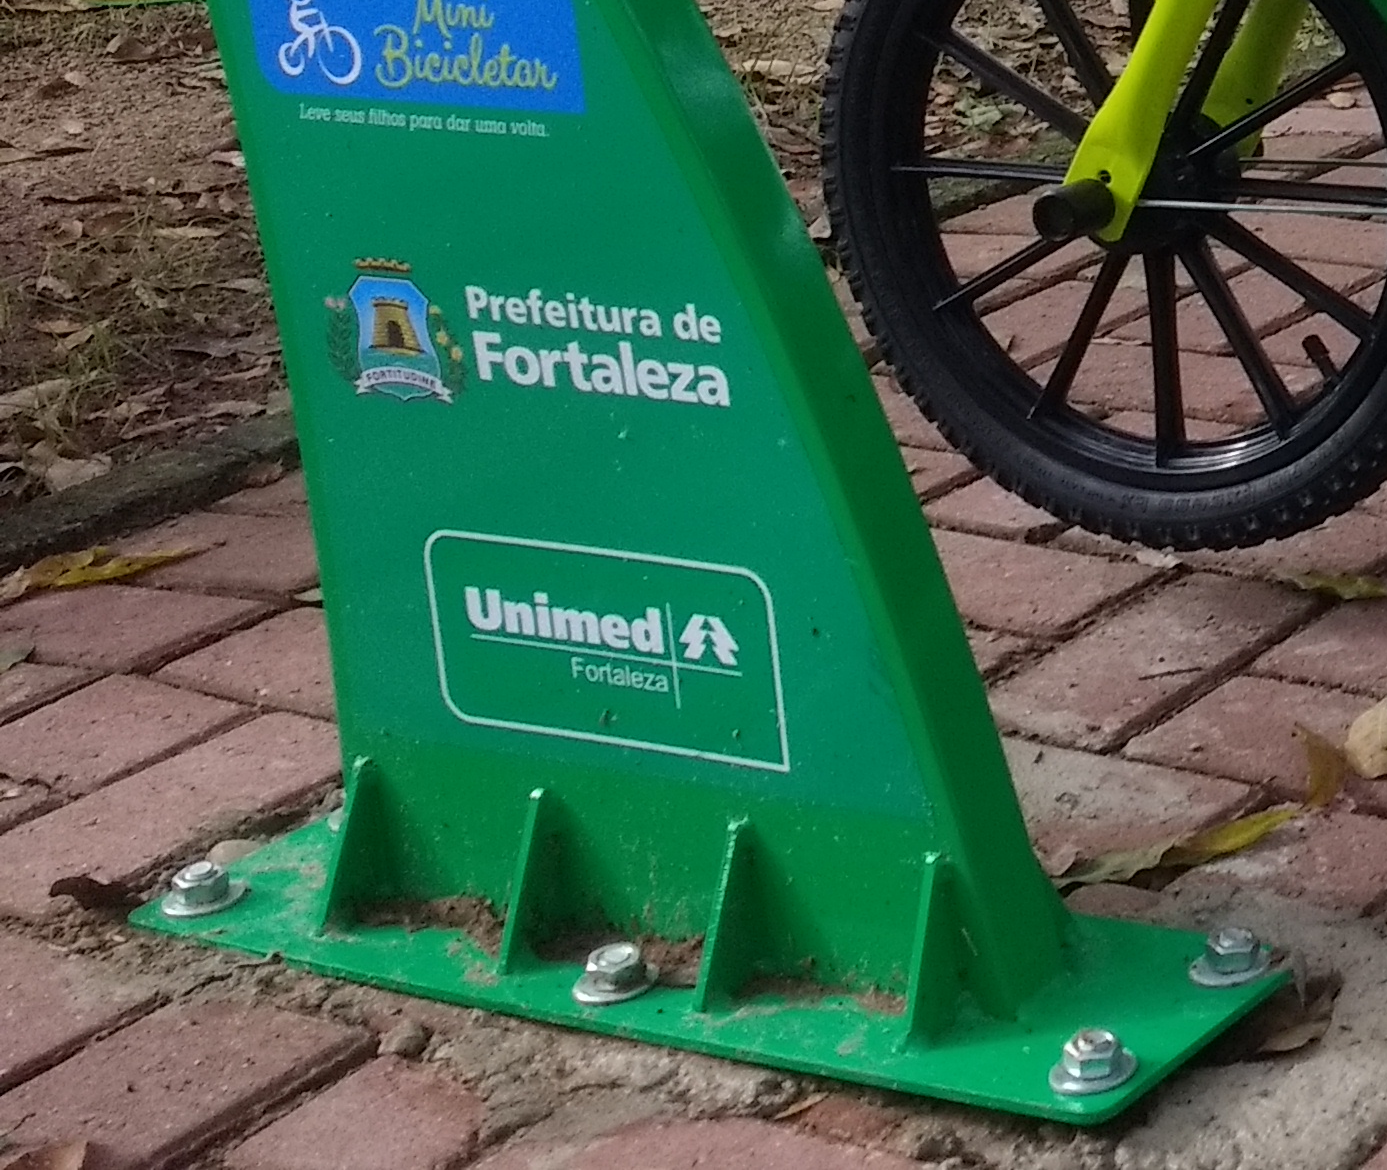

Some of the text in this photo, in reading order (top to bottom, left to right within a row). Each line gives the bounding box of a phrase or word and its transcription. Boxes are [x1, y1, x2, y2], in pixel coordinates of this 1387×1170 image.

[374, 25, 558, 91] Bicicletar
[299, 103, 549, 137] Leve seus filhos para dar uma volta.
[464, 285, 722, 344] Prefeitura de
[366, 370, 436, 390] FORTITUDINE
[472, 331, 732, 408] Fortaleza
[464, 586, 665, 655] Unimed
[571, 656, 670, 693] Fortaleza
